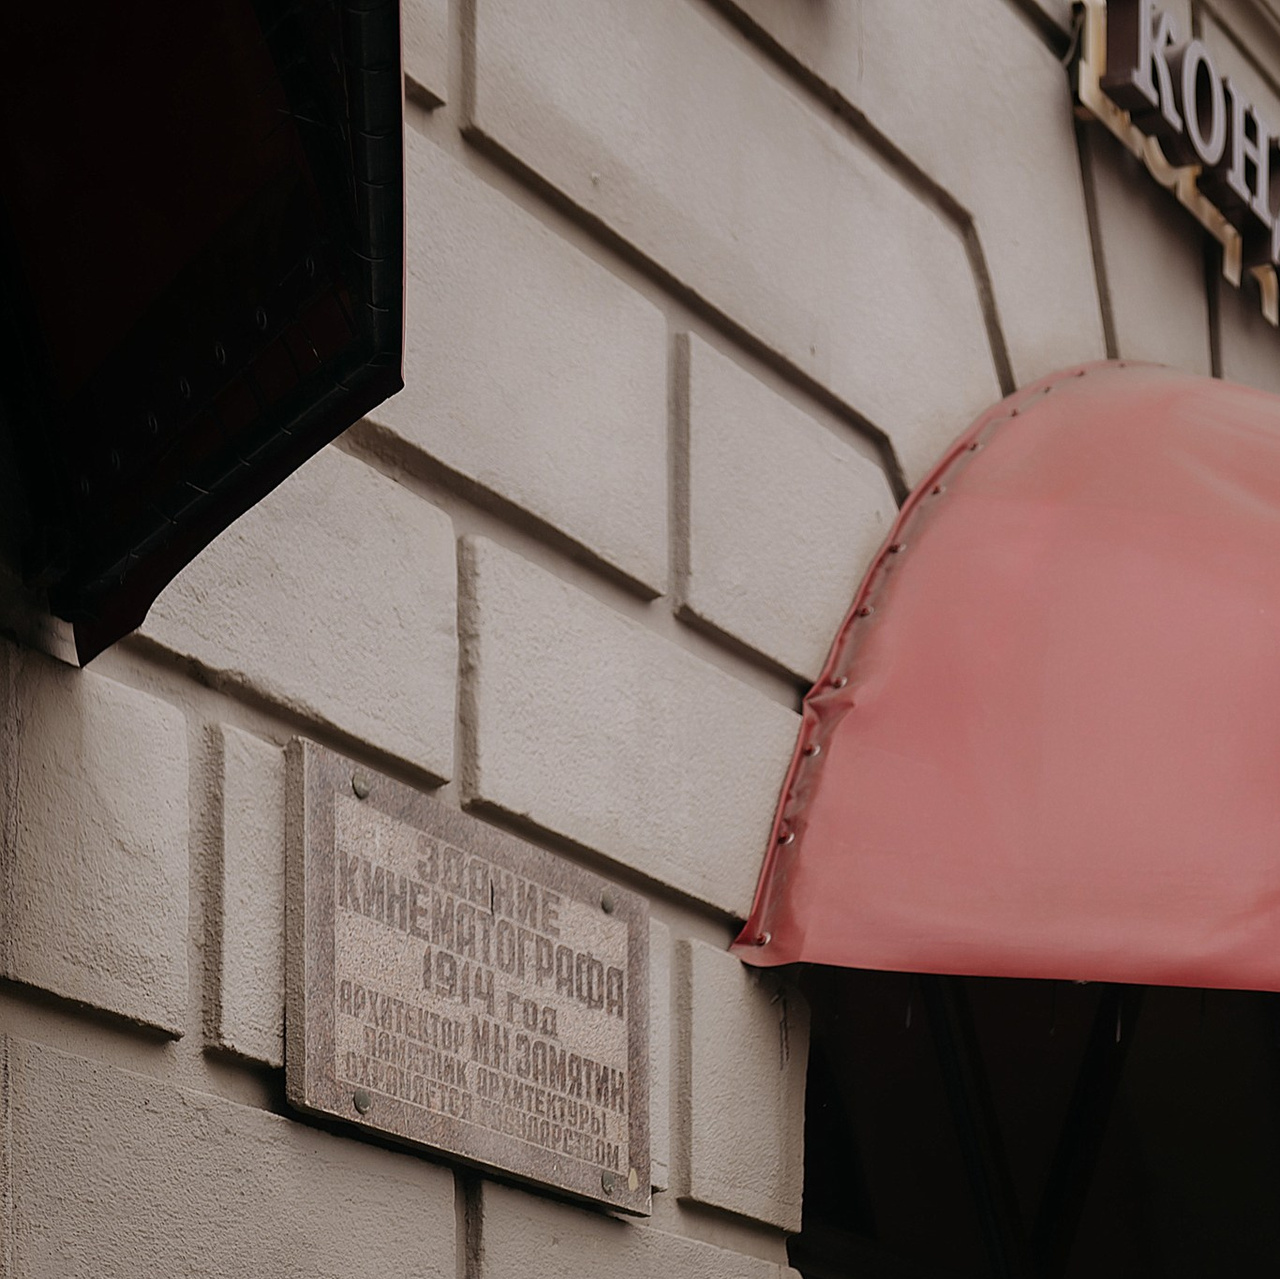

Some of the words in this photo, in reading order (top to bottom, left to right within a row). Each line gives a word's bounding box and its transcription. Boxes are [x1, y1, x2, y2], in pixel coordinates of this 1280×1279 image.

[337, 848, 624, 1021] КИНЕМАТОГРАФА
[416, 832, 560, 939] ЗДАНИЕ
[339, 977, 464, 1057] АРХИТЕКТОР
[422, 943, 495, 1017] 1914
[344, 1049, 472, 1122] ОХРАНЯЕТСЯ
[480, 1097, 619, 1171] ГОСУДАРСТВОМ
[363, 1024, 467, 1090] ПАМЯТНИК
[477, 1065, 606, 1138] АРХИТЕКТУРЫ
